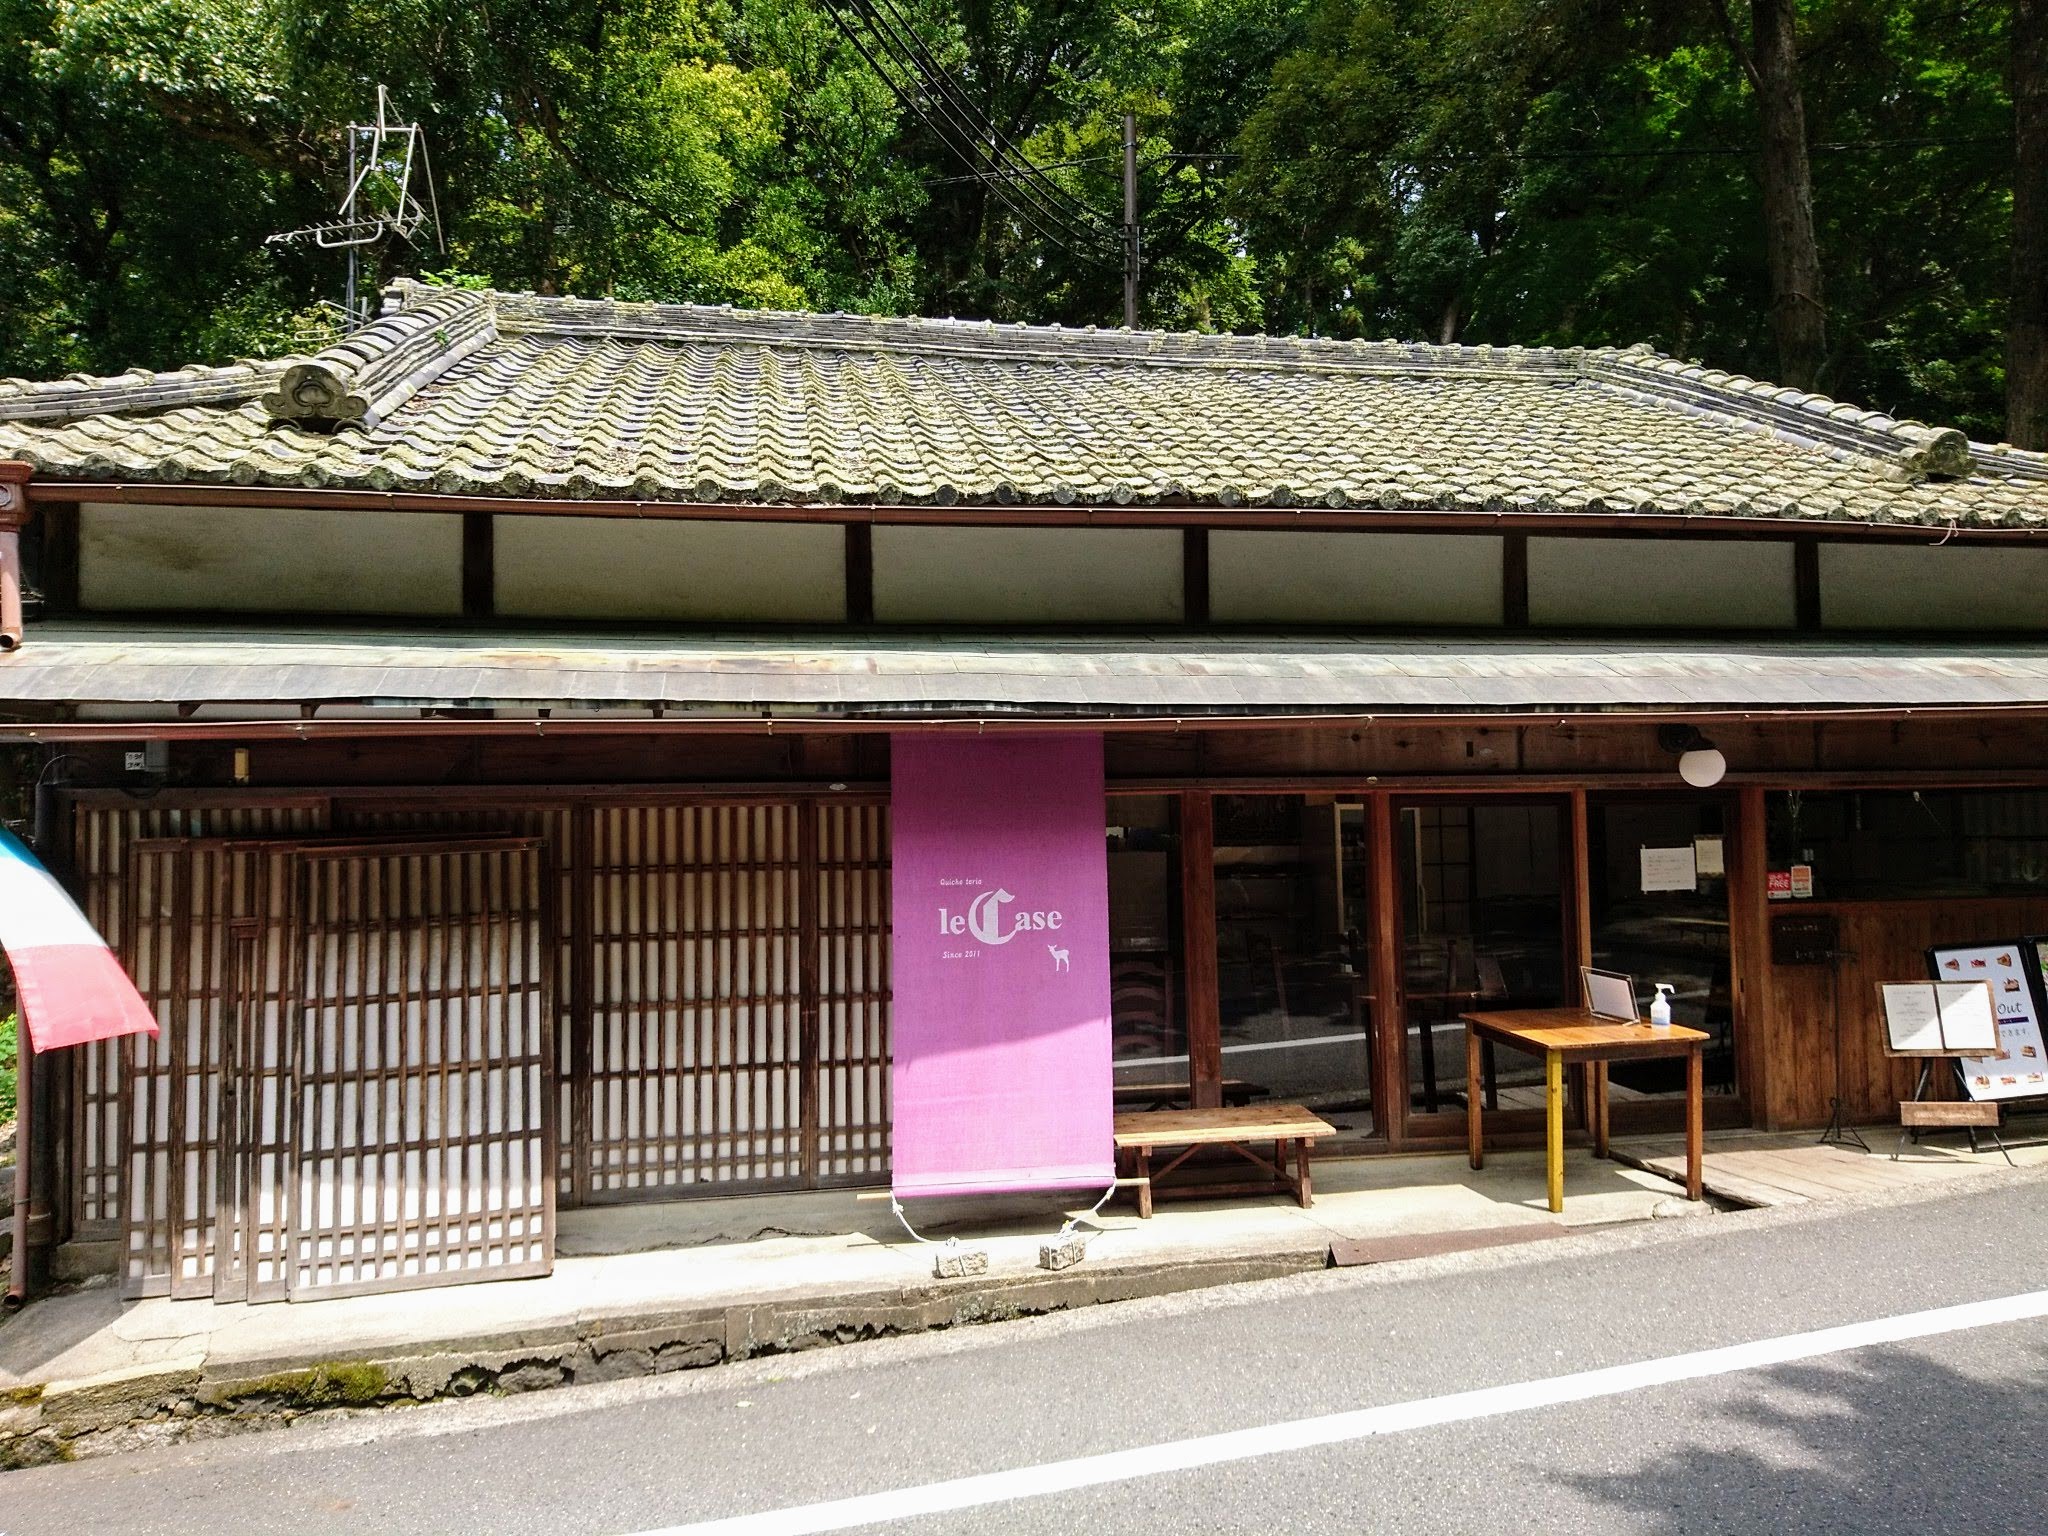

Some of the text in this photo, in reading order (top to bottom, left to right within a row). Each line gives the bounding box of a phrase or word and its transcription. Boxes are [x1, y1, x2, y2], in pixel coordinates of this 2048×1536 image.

[942, 950, 980, 959] Since 2011
[1997, 1002, 2022, 1014] Out
